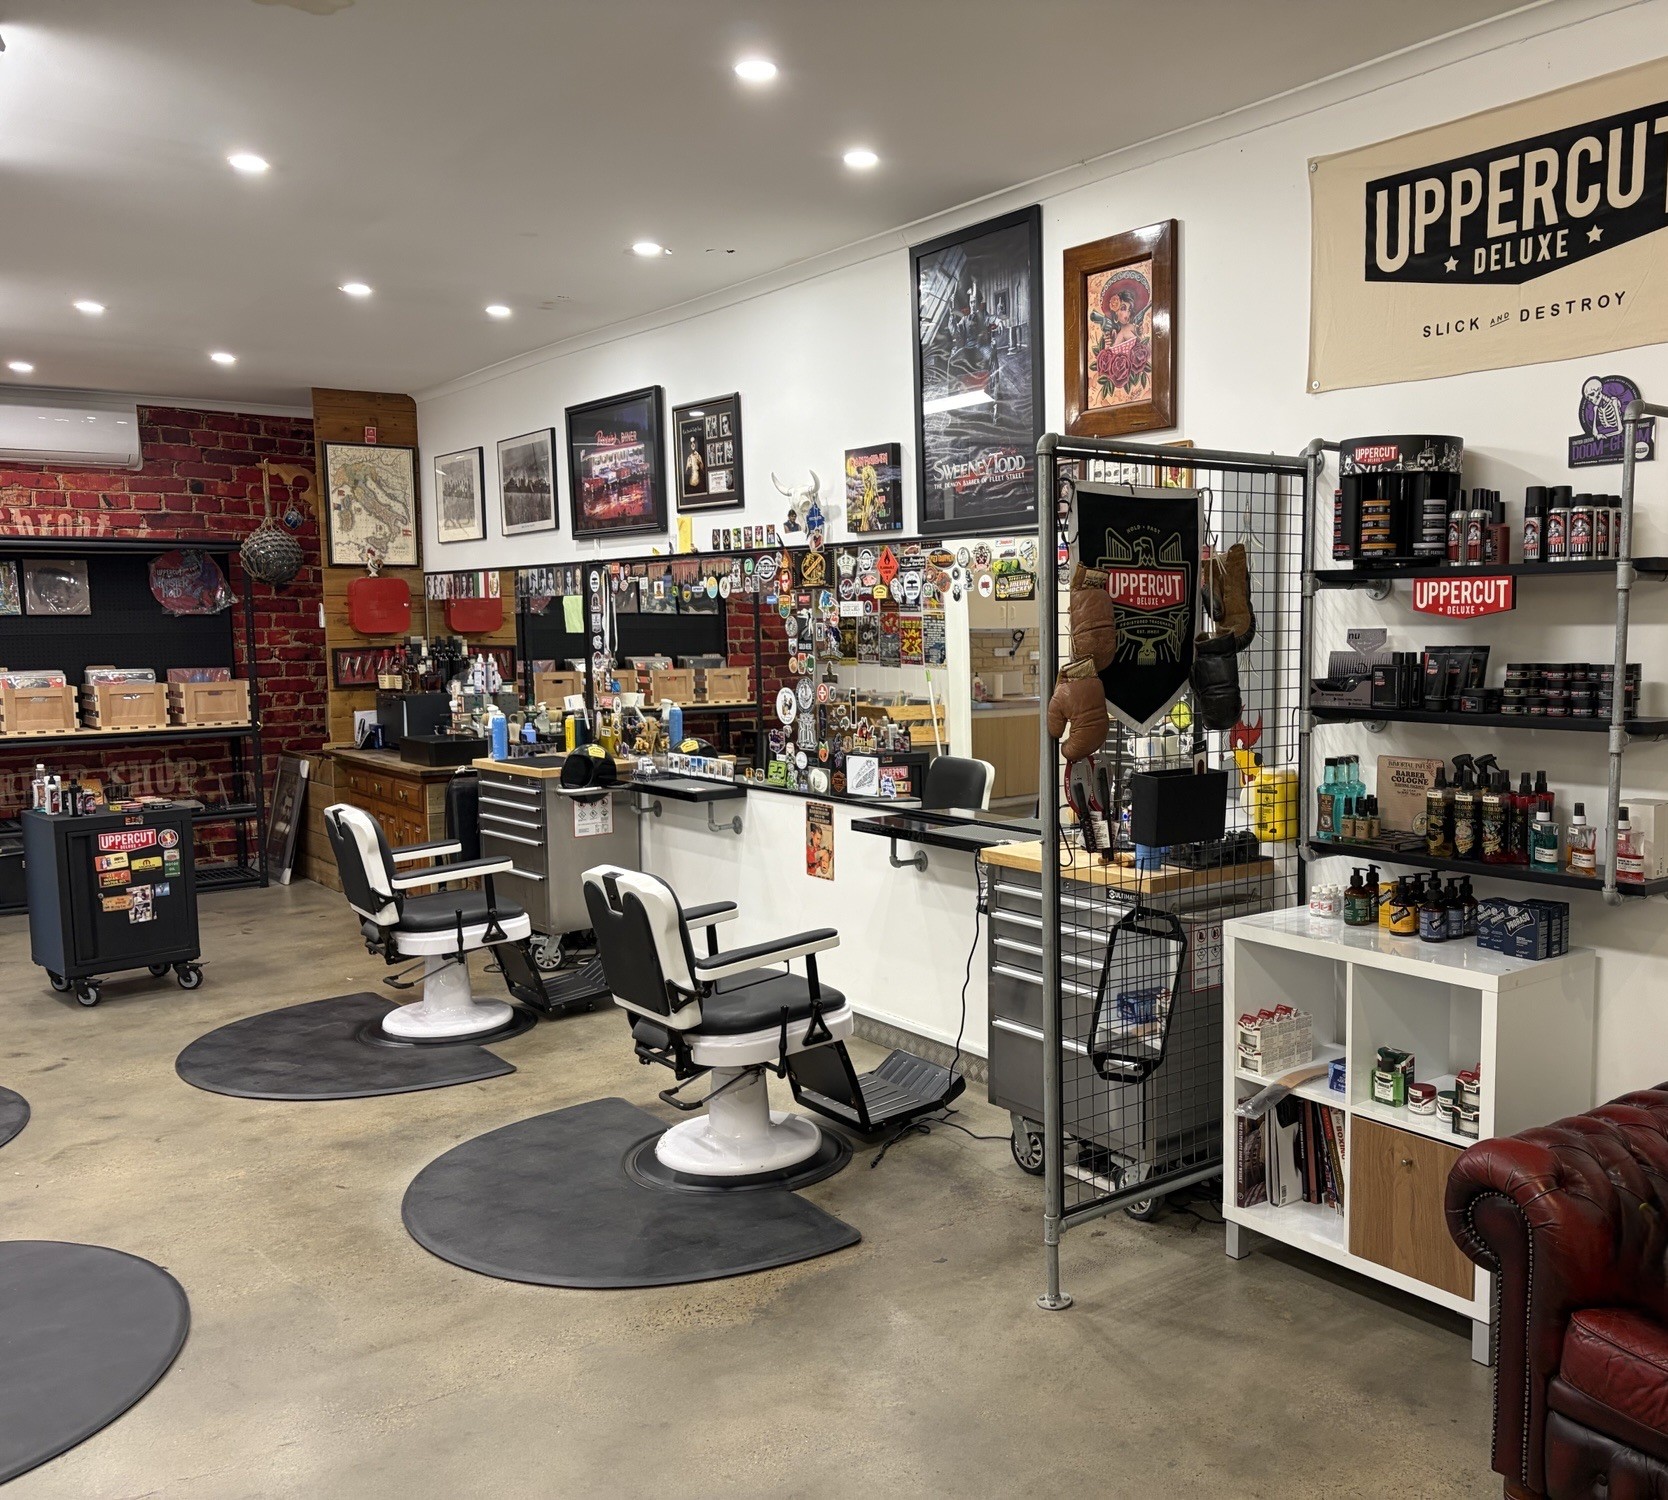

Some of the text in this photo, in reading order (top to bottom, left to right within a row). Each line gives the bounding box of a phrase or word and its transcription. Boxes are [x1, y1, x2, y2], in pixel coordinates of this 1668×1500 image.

[1473, 228, 1569, 275] DELUXE
[1422, 291, 1627, 338] SLICK AND DESTROY
[1354, 445, 1398, 461] UPPERCUT
[932, 451, 1026, 482] SWEENEY TODD
[933, 482, 943, 490] THE
[989, 474, 1004, 483] FLEET
[1005, 472, 1025, 481] STREET
[1108, 572, 1182, 600] UPPERCUT
[1415, 579, 1510, 609] UPPERCUT
[1136, 597, 1159, 606] DELUXE
[1446, 605, 1475, 615] DELUXE
[108, 757, 198, 797] SHOP
[1390, 776, 1429, 786] COLOGNE
[1395, 770, 1425, 779] BARBER
[100, 831, 154, 848] UPPERCUT
[1506, 912, 1531, 931] PRORASO
